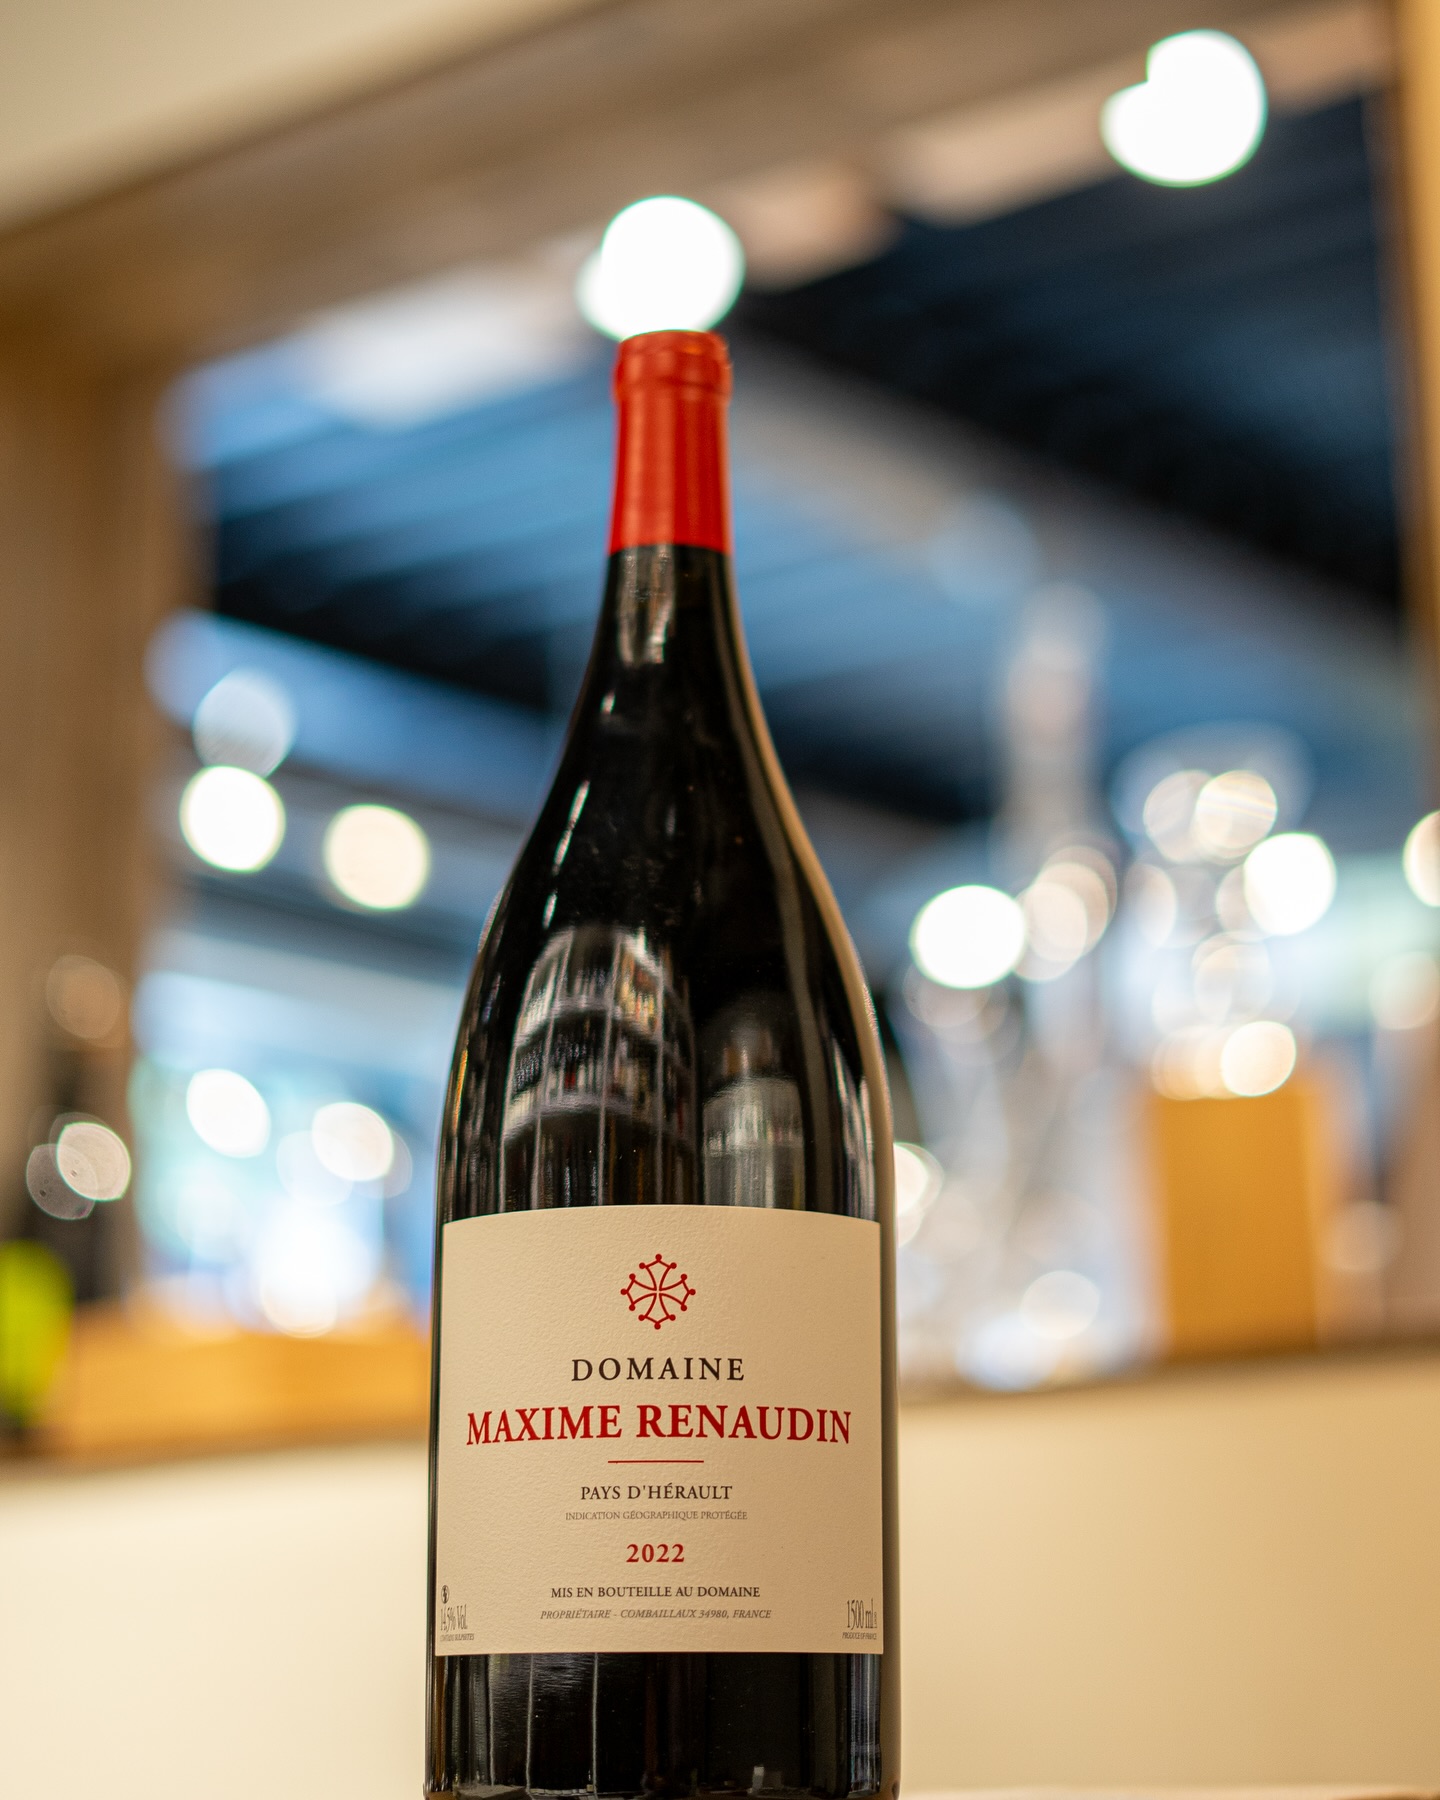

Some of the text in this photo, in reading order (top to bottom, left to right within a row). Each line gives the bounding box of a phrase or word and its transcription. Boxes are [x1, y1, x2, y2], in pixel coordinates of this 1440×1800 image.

[571, 1357, 745, 1382] DOMAINE
[466, 1404, 852, 1446] MAXIME RENAUDIN
[581, 1482, 733, 1500] PAYS D'HÉRAULT
[565, 1510, 748, 1521] INDICATION GÉOGRAPHIQUE PROTÉGÉE
[626, 1543, 685, 1563] 2022
[551, 1586, 761, 1598] MIS EN BOUTEILLE AU DOMAINE
[540, 1608, 612, 1620] PROPRIÉTAIRE
[620, 1608, 697, 1619] COMBAILLAUX
[697, 1609, 730, 1620] 34980,
[732, 1609, 772, 1619] FRANCE
[847, 1599, 864, 1630] 1500
